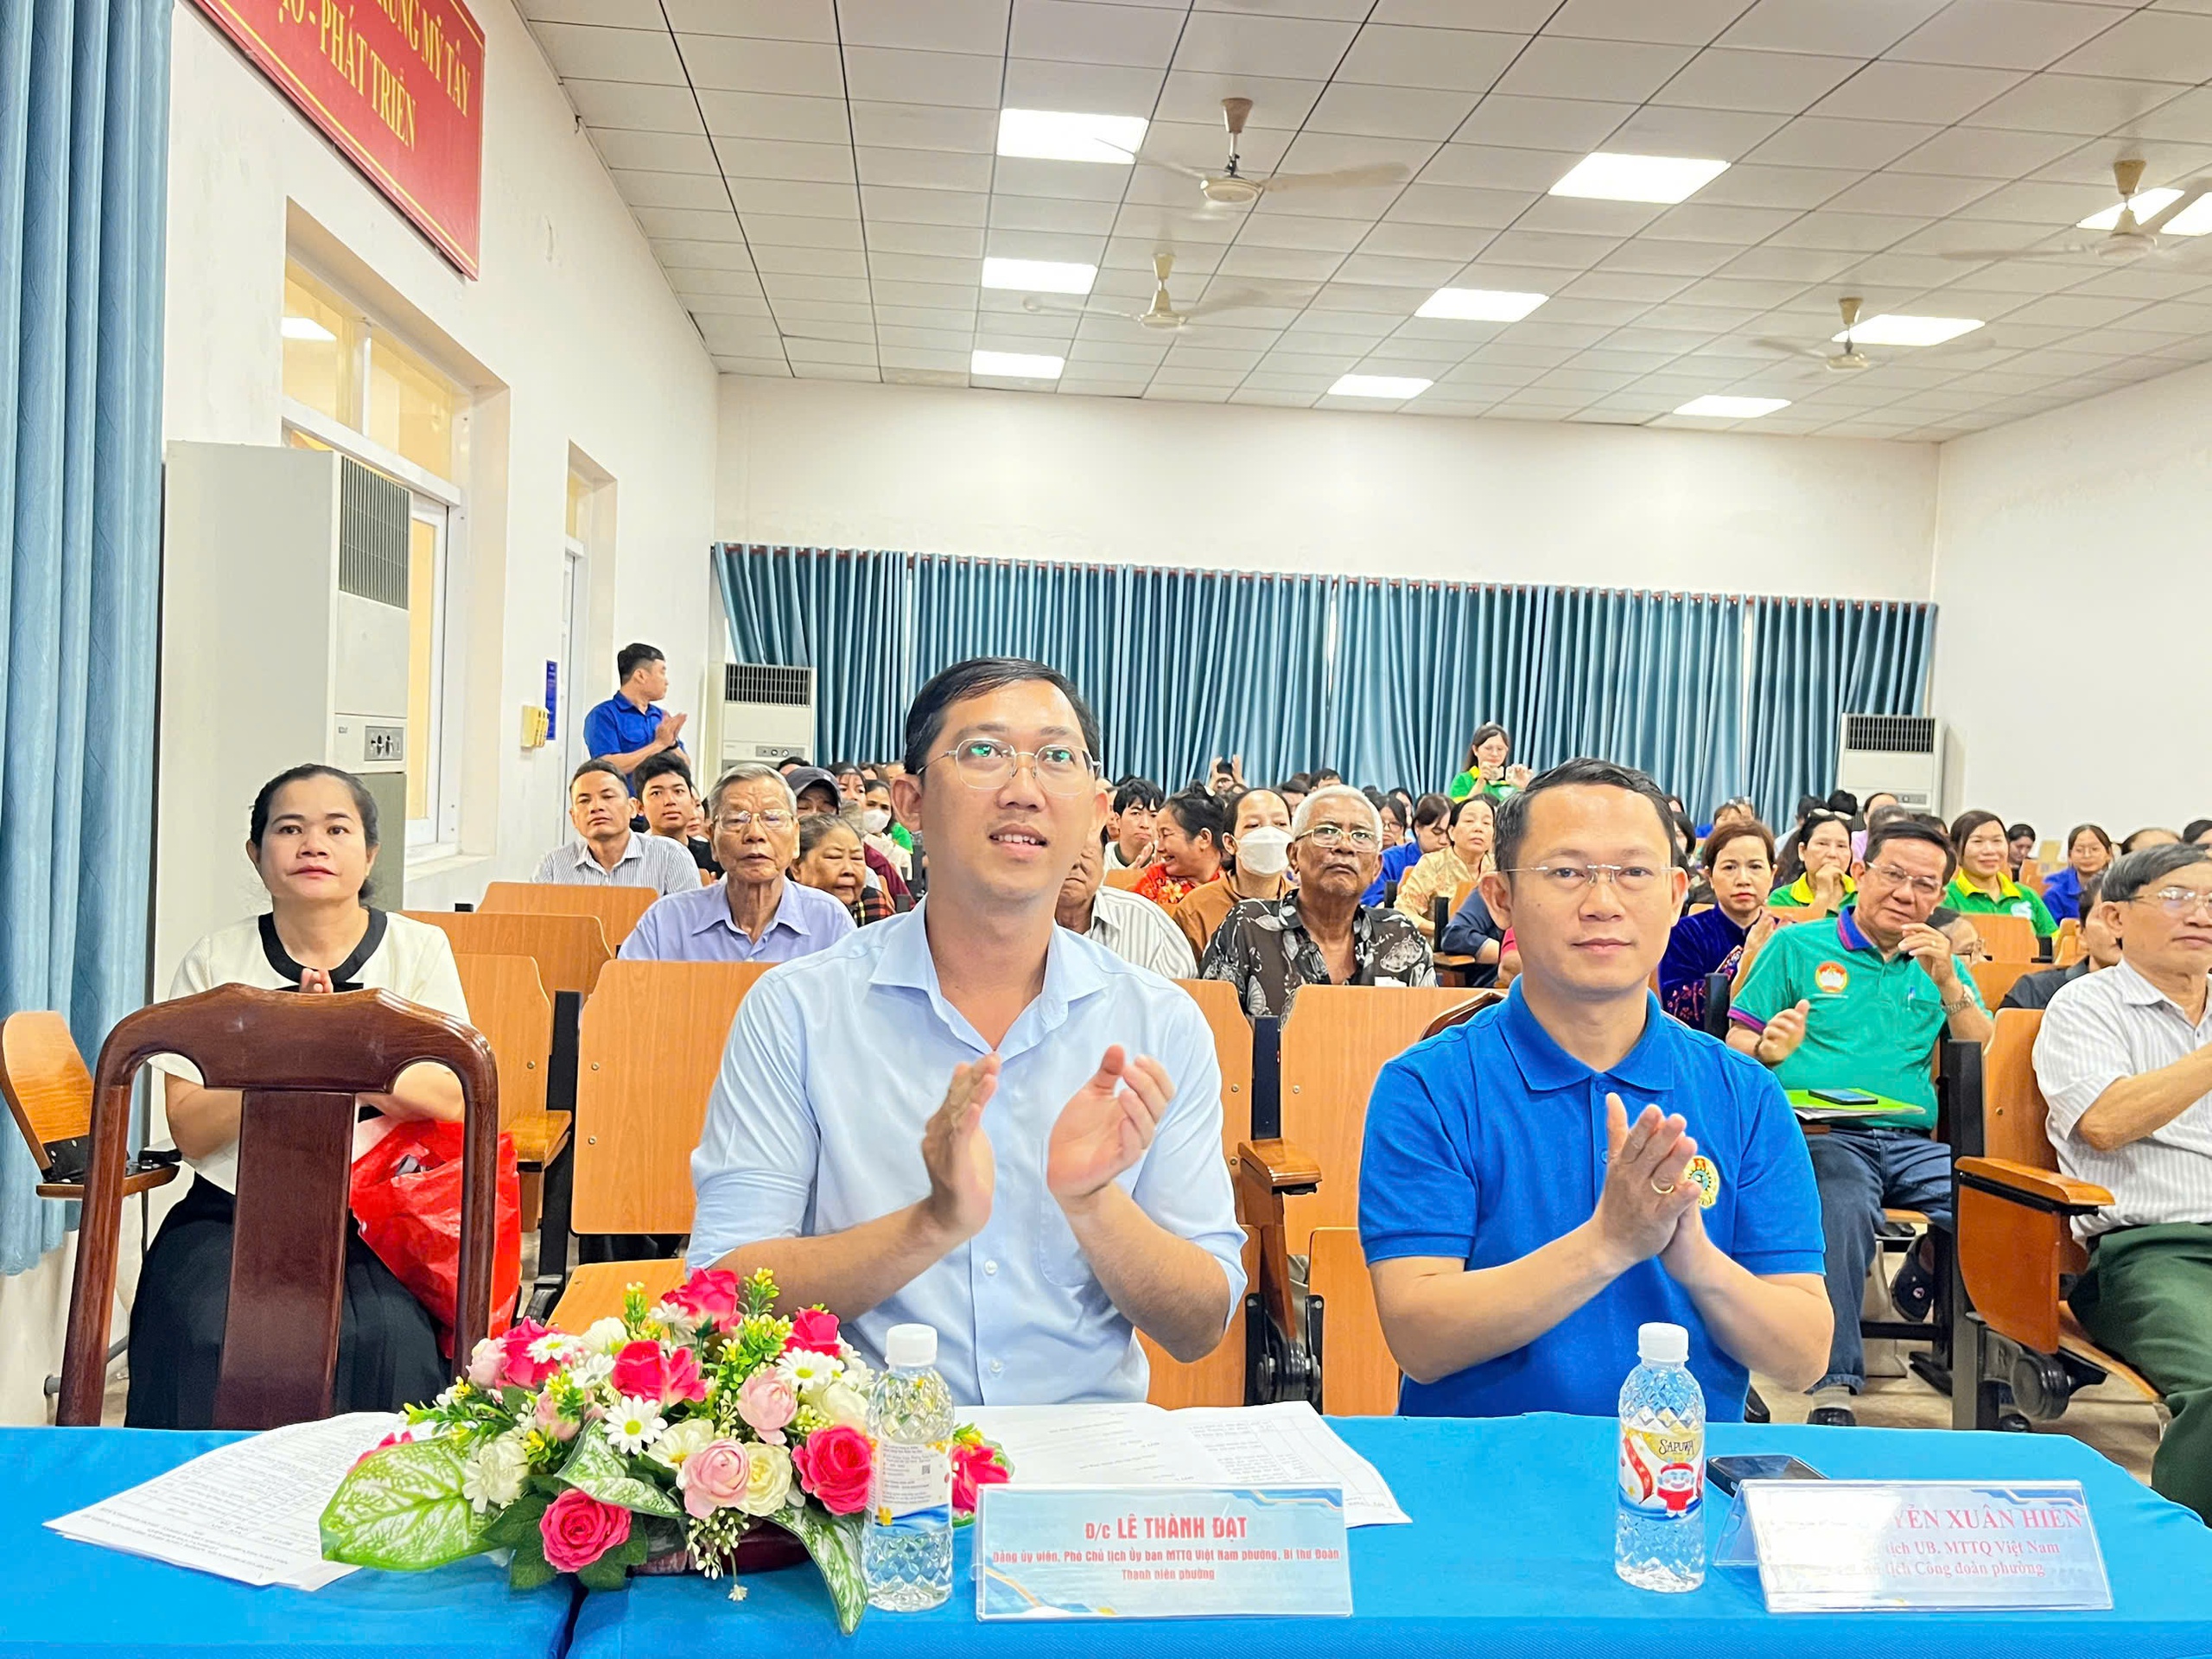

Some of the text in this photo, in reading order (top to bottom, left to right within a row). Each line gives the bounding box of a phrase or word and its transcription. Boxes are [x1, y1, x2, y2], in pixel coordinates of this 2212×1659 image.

[320, 0, 368, 97] PHÁT
[370, 48, 416, 153] TRIỂN
[445, 39, 471, 118] TÂY
[1117, 1513, 1137, 1539] LÊ
[1144, 1512, 1205, 1539] THÀNH
[1211, 1516, 1247, 1542] ĐẠT
[1945, 1503, 2016, 1529] XUÂN
[1064, 1550, 1082, 1562] Phó
[1085, 1549, 1104, 1562] Chủ
[1107, 1549, 1126, 1564] tịch
[1145, 1550, 1163, 1561] ban
[1166, 1549, 1192, 1561] MTTQ
[1196, 1549, 1214, 1563] Việt
[1217, 1549, 1238, 1560] Nam
[1315, 1548, 1339, 1560] Đoàn
[1914, 1541, 1941, 1554] UB.
[1944, 1541, 1992, 1556] MTTQ
[1995, 1540, 2023, 1557] Việt
[2026, 1540, 2060, 1554] Nam
[1122, 1568, 1215, 1580] Thanh niên phường
[1915, 1560, 1953, 1578] Công
[1955, 1560, 1987, 1575] đoàn
[1991, 1560, 2045, 1578] phường
